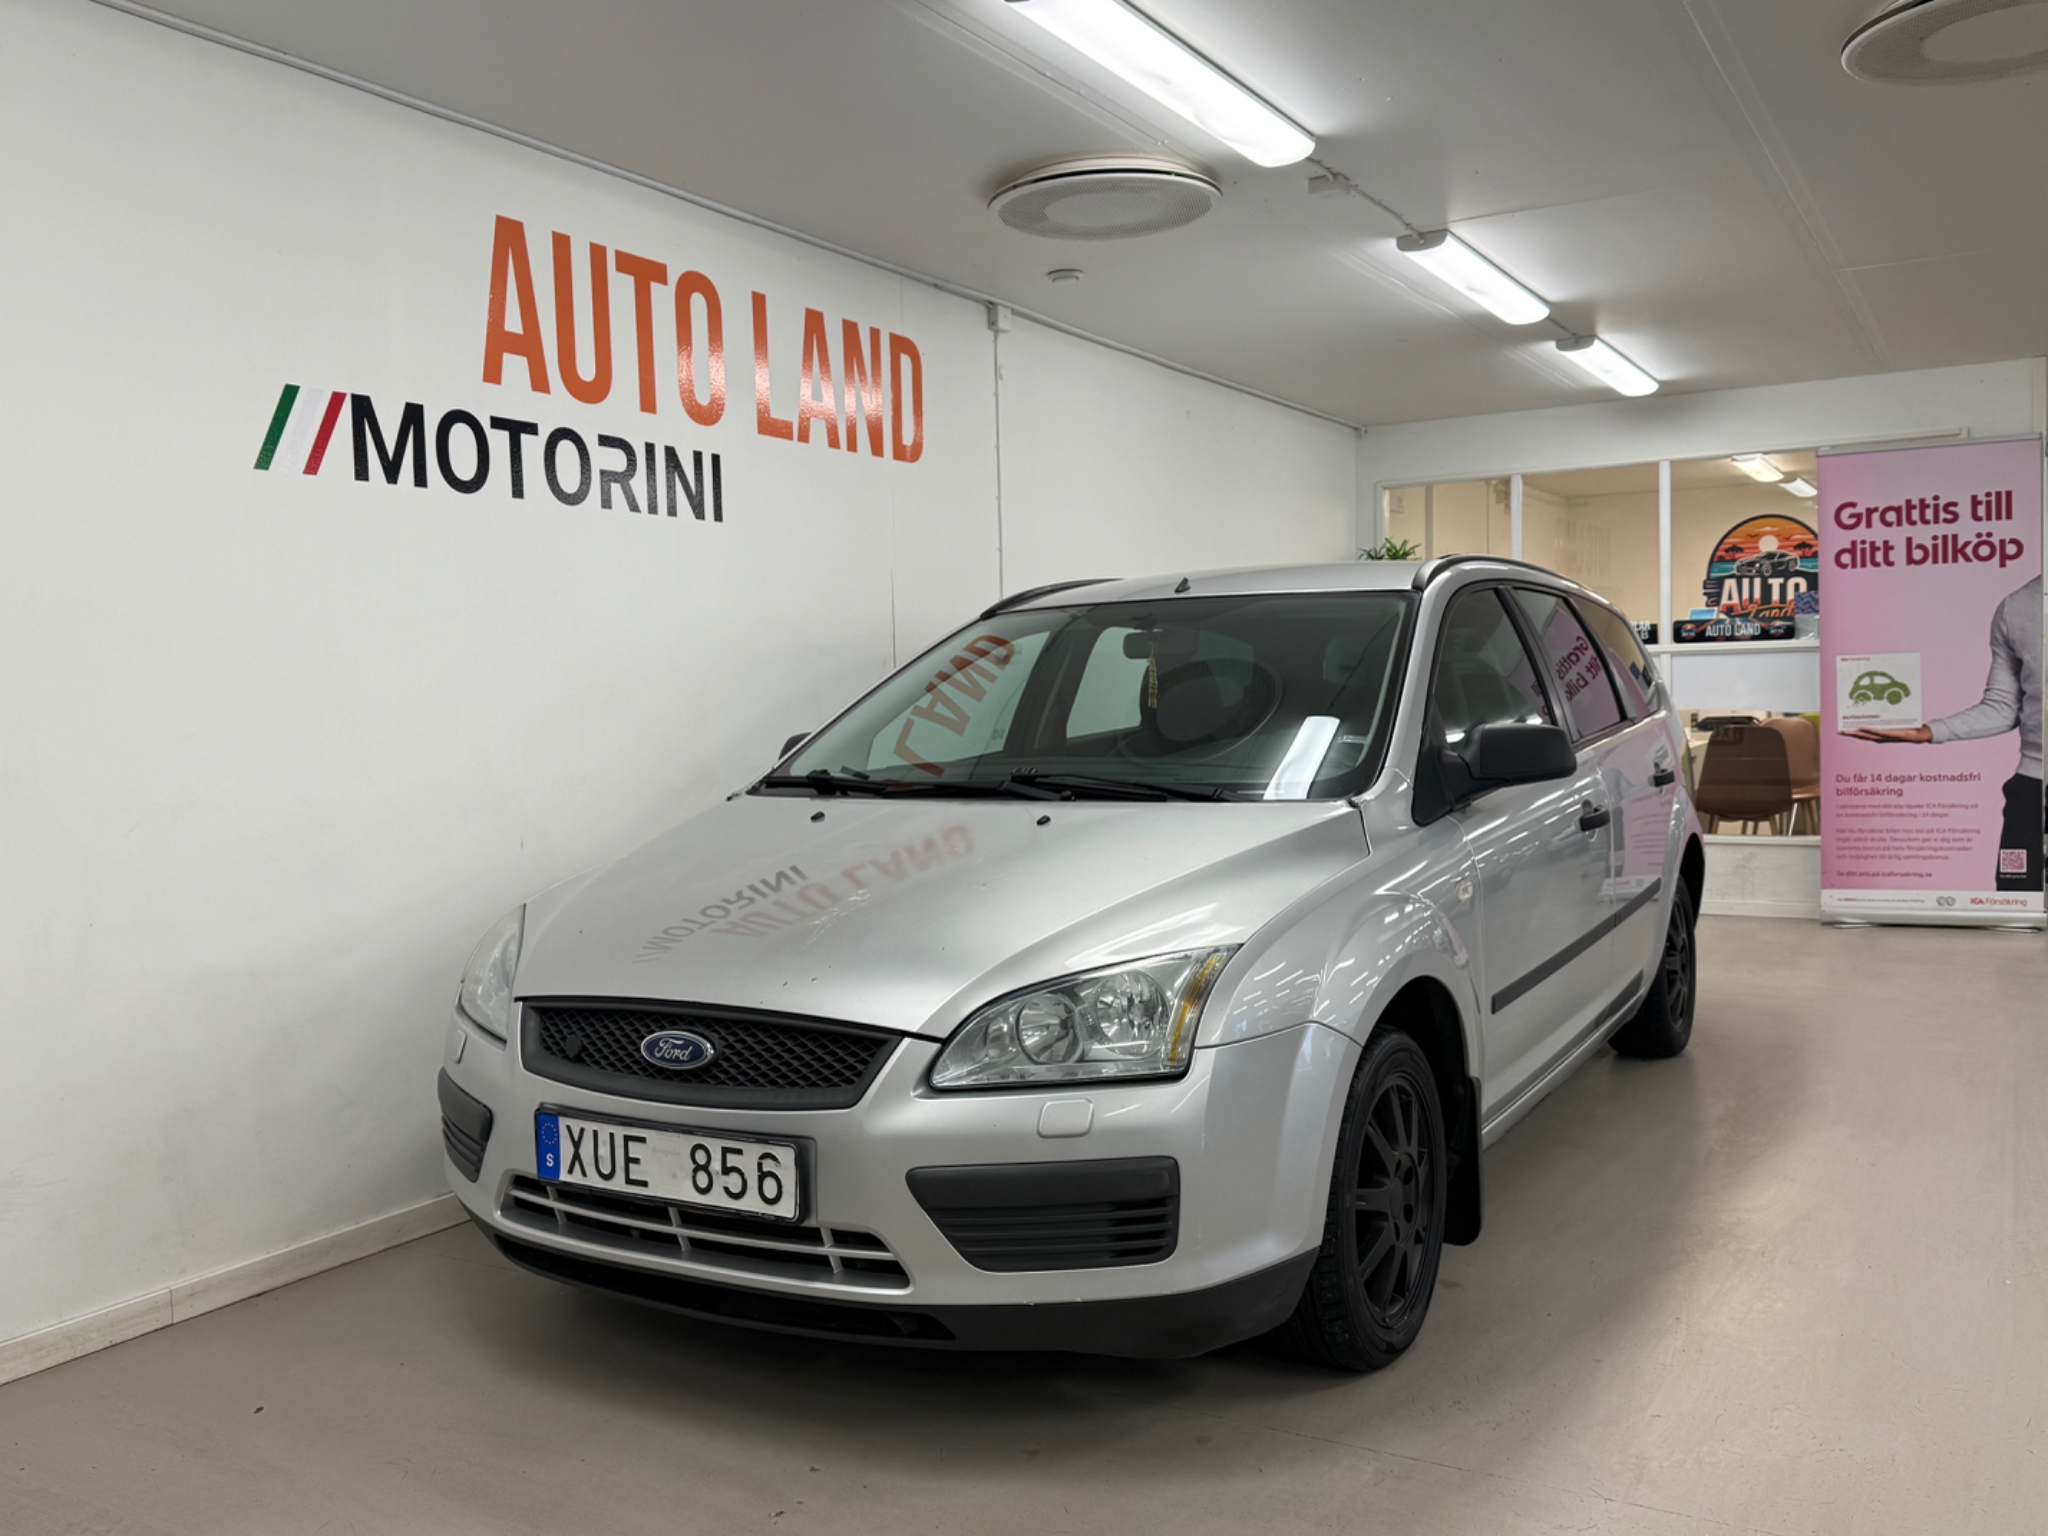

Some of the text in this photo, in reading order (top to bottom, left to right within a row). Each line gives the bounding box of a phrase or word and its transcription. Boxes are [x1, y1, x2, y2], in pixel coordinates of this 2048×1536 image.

[483, 214, 925, 463] AUTO LAND
[1834, 490, 2014, 531] Grattis till
[1834, 531, 2025, 570] ditt bilköp
[1719, 577, 1808, 613] AUTO
[1705, 624, 1732, 637] AUTO
[1734, 622, 1761, 636] LAND
[1836, 771, 1982, 785] Du får 14 dagar kostnadsfri
[1836, 785, 1904, 798] bilförsäkring
[1970, 897, 1984, 905] ICA
[654, 1038, 693, 1061] Ford
[546, 1153, 554, 1167] S
[566, 1124, 783, 1205] XUE 856
